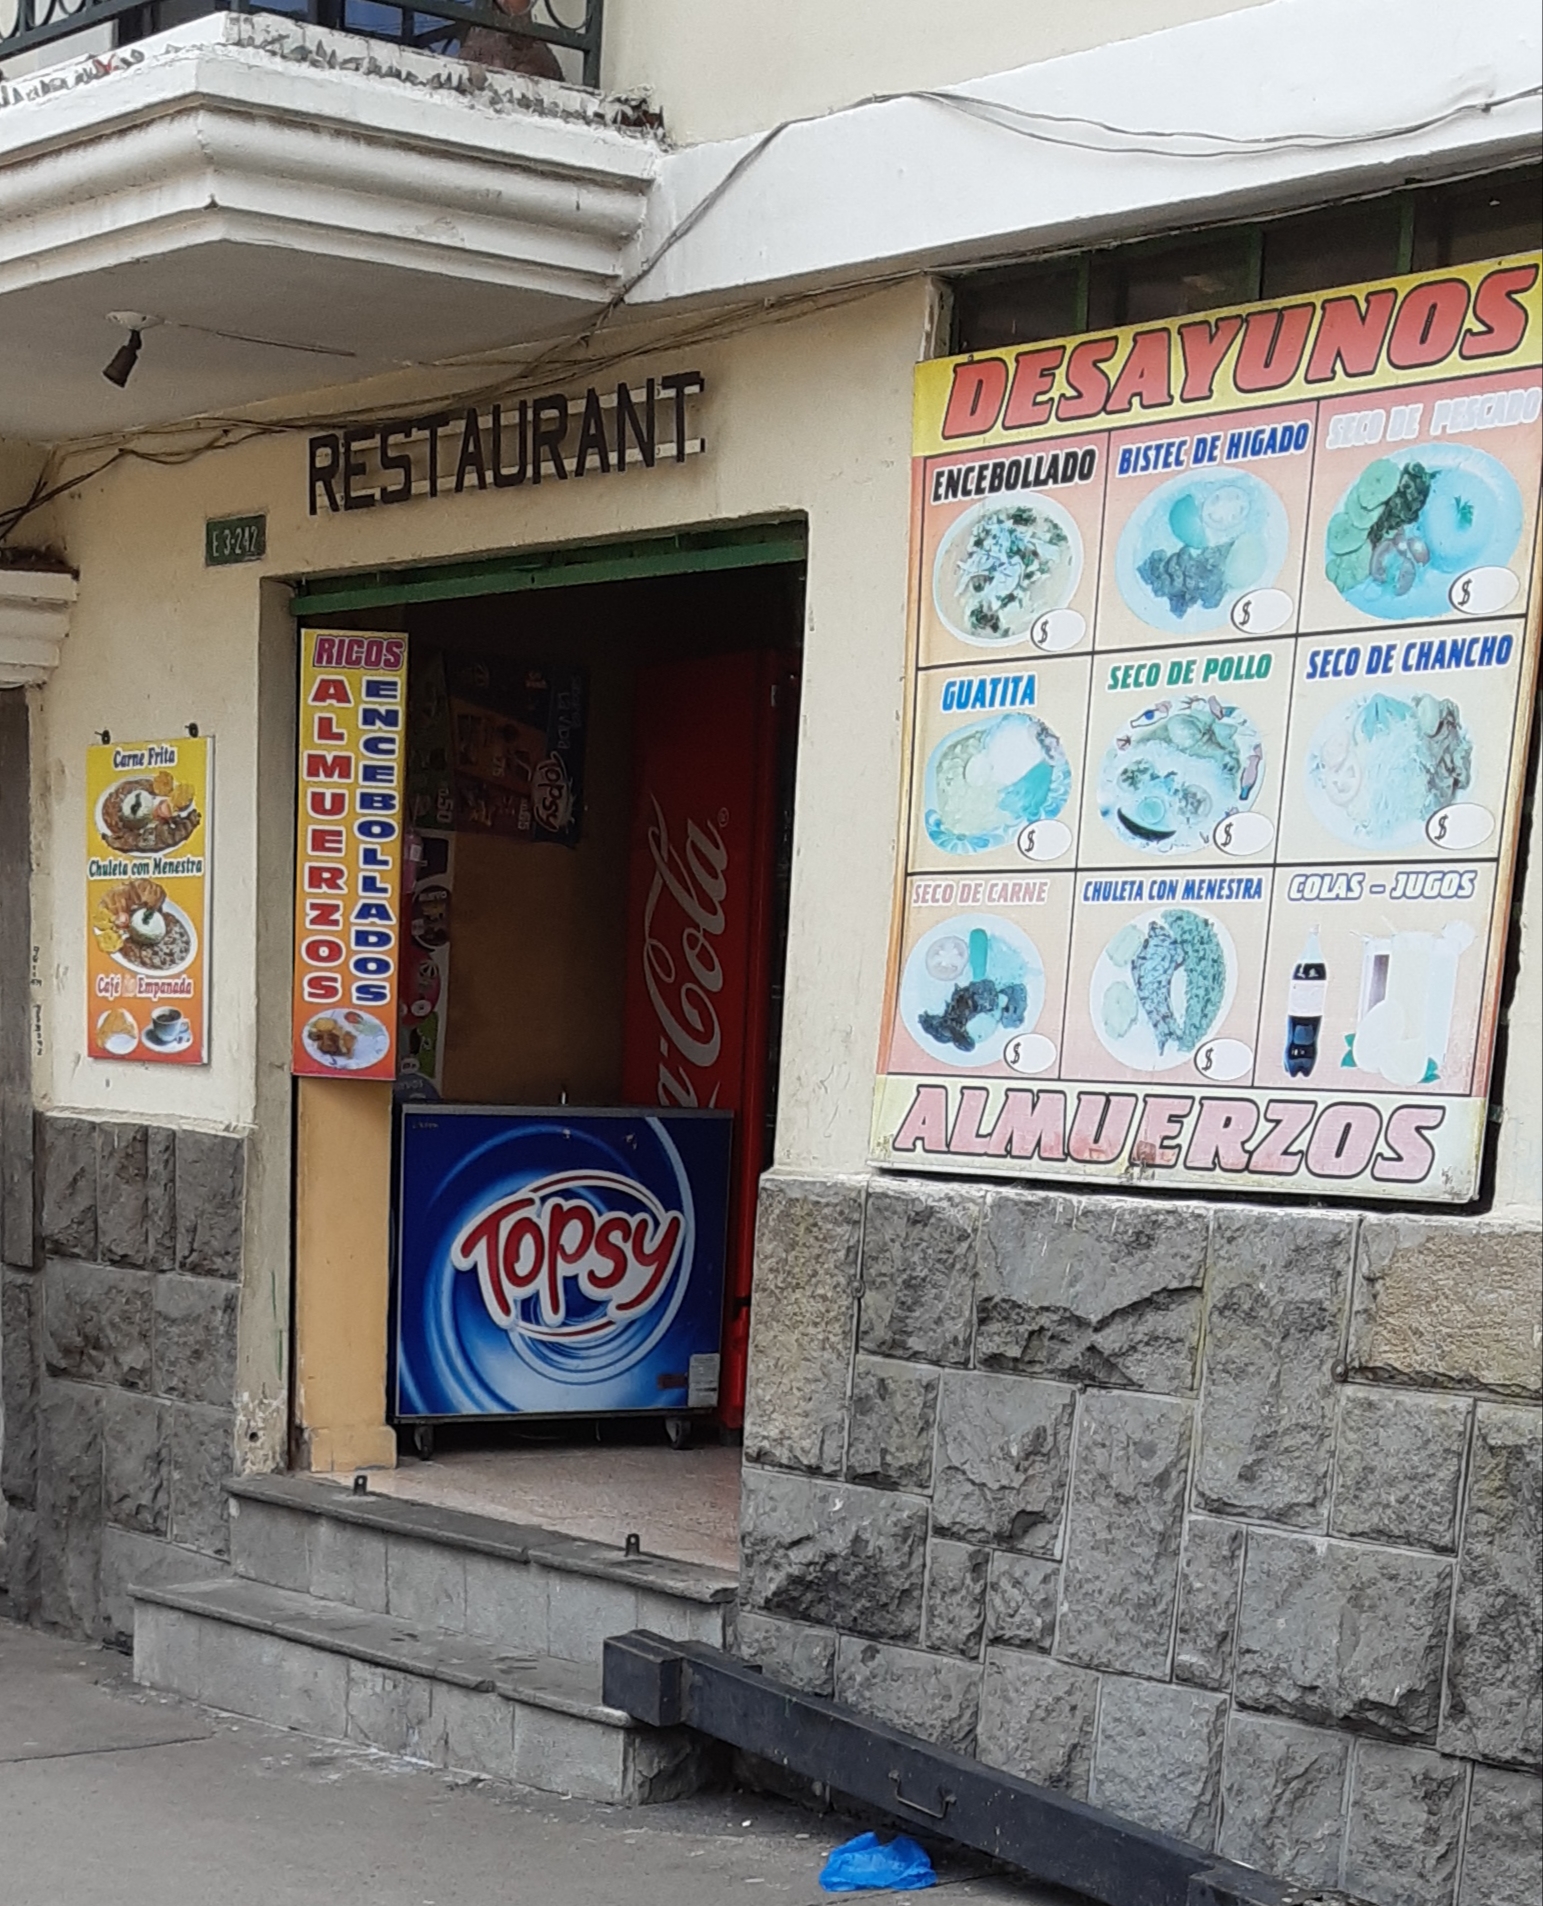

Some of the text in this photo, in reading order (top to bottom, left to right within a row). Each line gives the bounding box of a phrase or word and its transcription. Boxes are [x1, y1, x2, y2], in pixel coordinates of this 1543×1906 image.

[941, 265, 1541, 440] DESAYUNOS
[1326, 410, 1385, 449] SECO
[1430, 387, 1542, 435] PESCADO
[309, 371, 705, 516] RESTAURANT
[1117, 422, 1310, 475] BISTEC DE HIGADO
[932, 448, 1097, 502] ENCEBOLLADO
[1457, 578, 1473, 607] $
[1239, 600, 1252, 627] $
[1037, 619, 1049, 644] $
[314, 634, 405, 671] RICOS
[1305, 634, 1515, 679] SECO DE CHANCHO
[1107, 653, 1273, 690] SECO DE POLLO
[942, 674, 1037, 711] GUATITA
[113, 746, 176, 768] Carne Frita
[303, 675, 355, 1003] ALMUERZOS
[350, 676, 401, 1005] ENCEBOLLADOS
[1025, 829, 1037, 852] $
[1220, 822, 1234, 848] $
[1434, 814, 1449, 841] $
[88, 856, 203, 877] Chuleta con Menestra
[913, 880, 1049, 904] SECO DE CARNE
[1082, 877, 1263, 902] CHULETA CON MENESTRA
[1288, 872, 1367, 901] COLAS
[1390, 870, 1478, 900] JUGOS
[97, 976, 121, 998] Café
[137, 975, 193, 998] Empanada
[1010, 1042, 1022, 1065] $
[1201, 1047, 1214, 1071] $
[893, 1084, 1446, 1183] ALMUERZOS
[454, 1194, 686, 1327] Topsy
